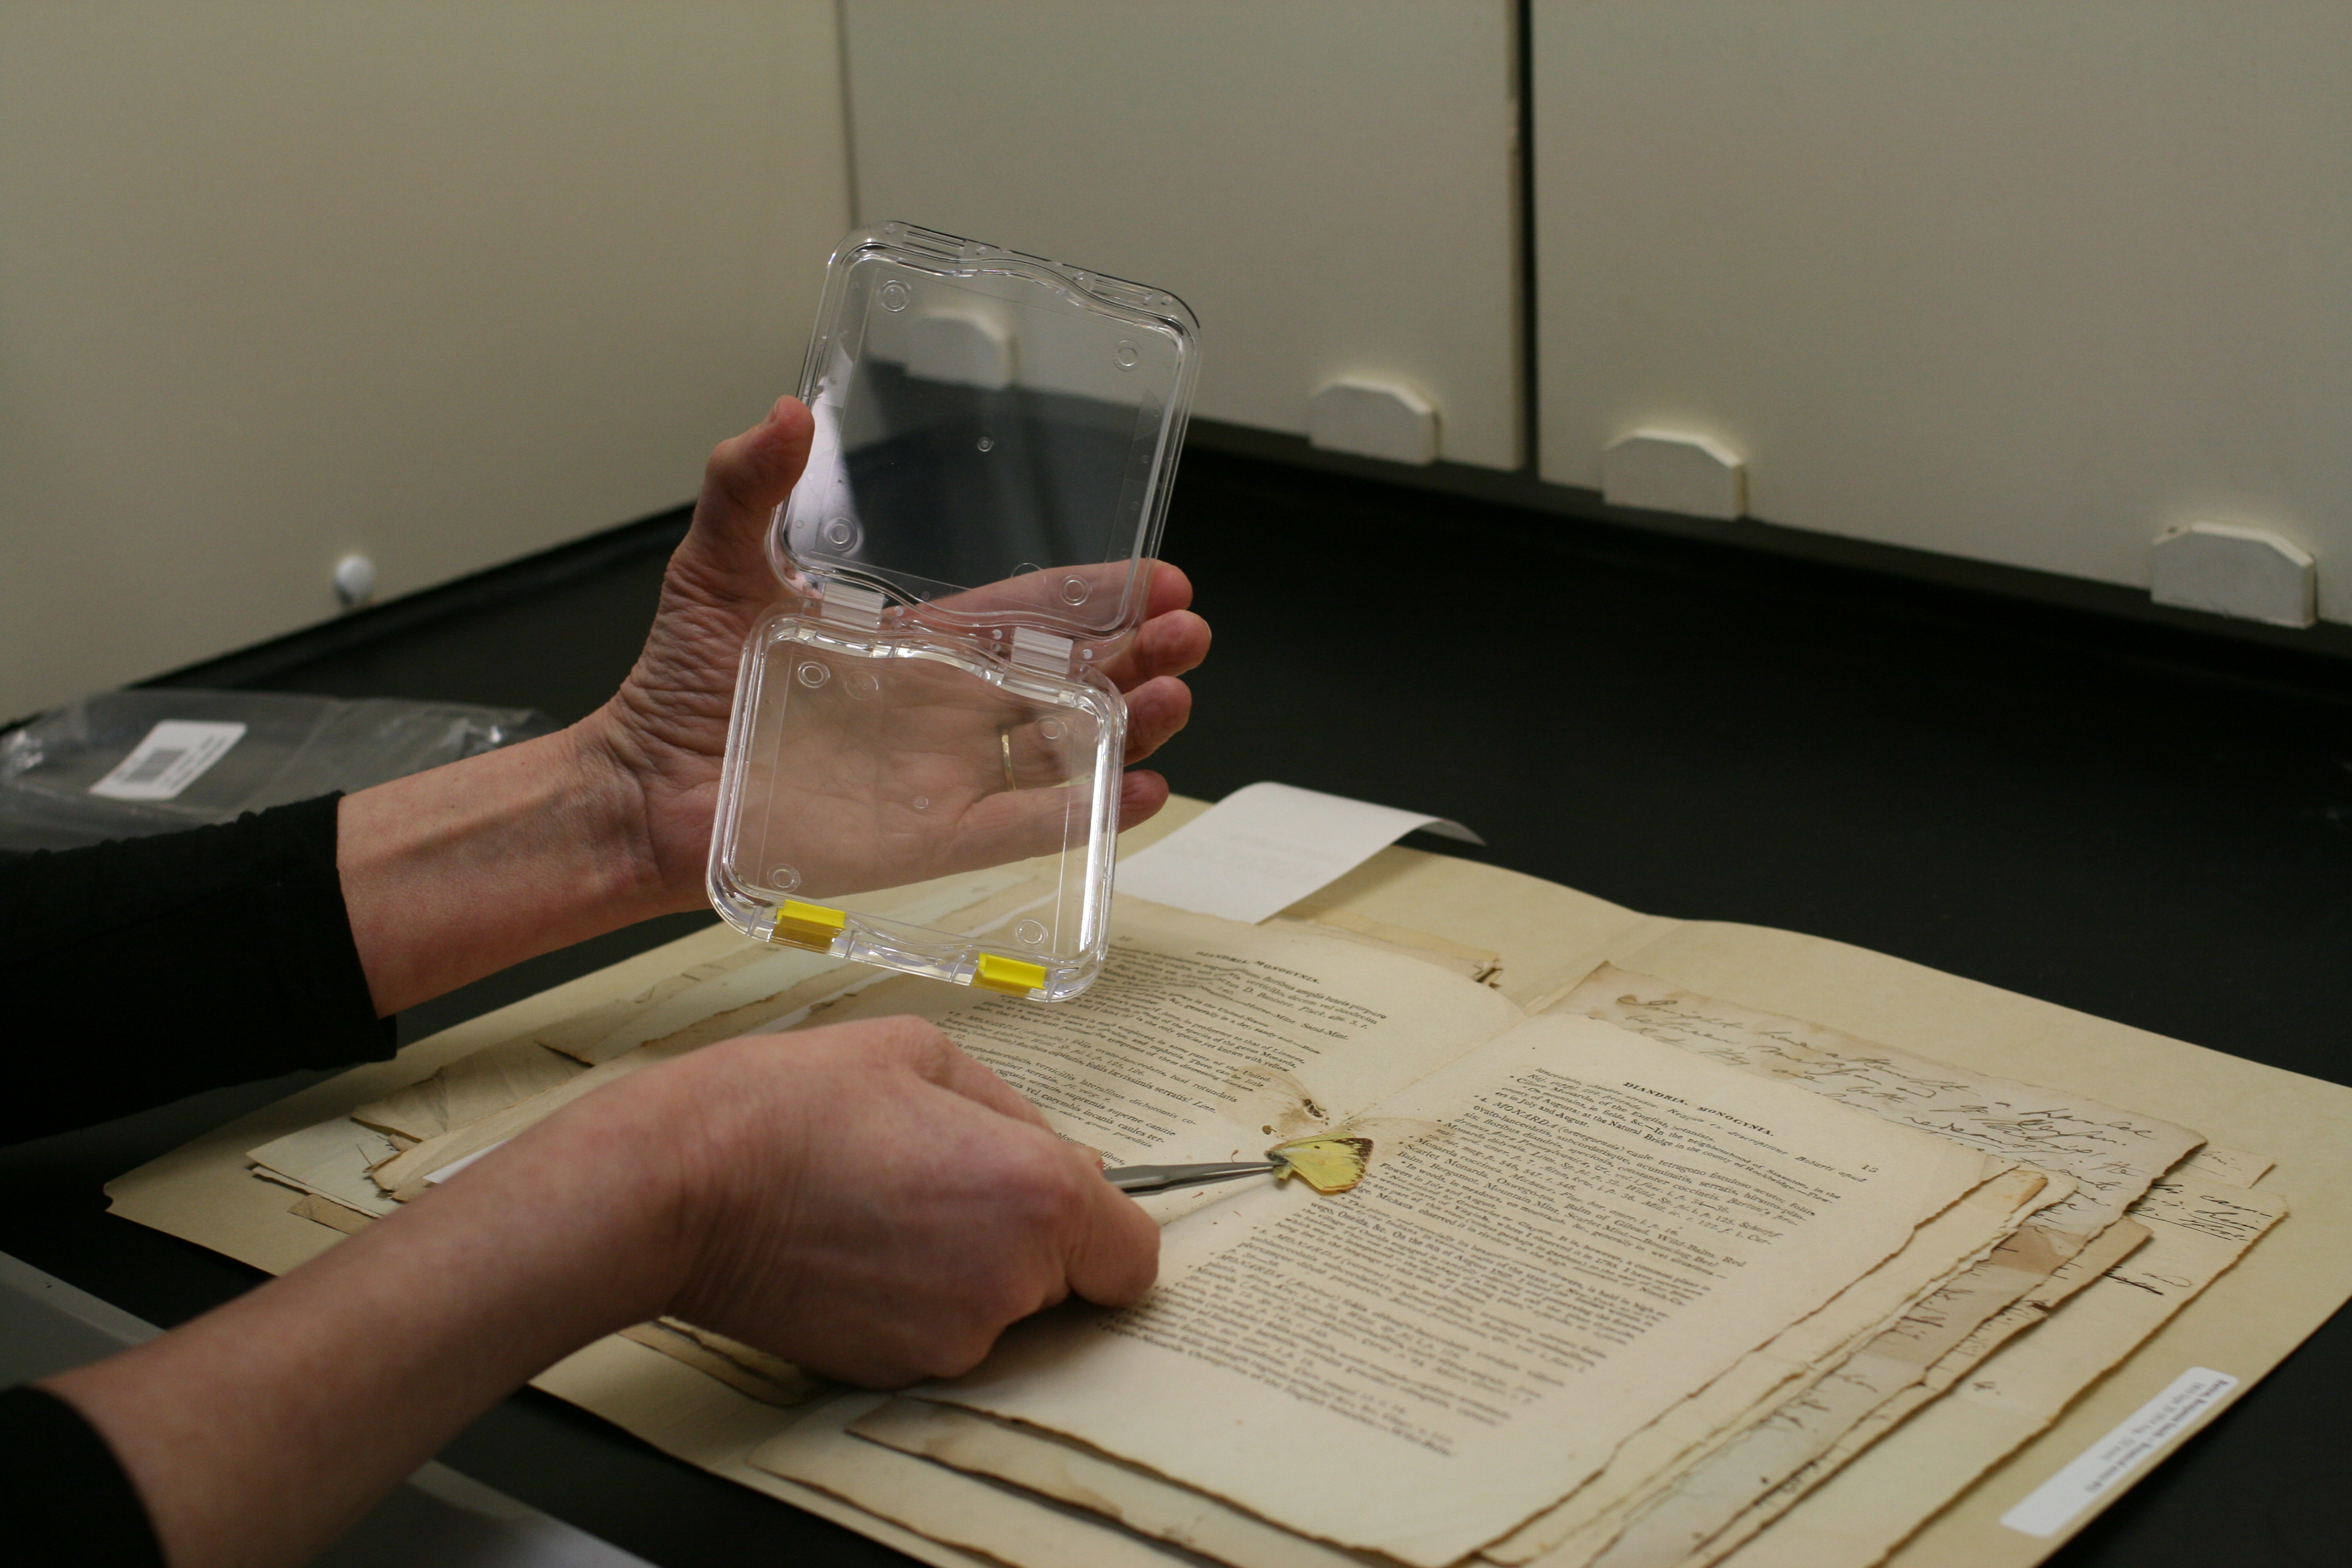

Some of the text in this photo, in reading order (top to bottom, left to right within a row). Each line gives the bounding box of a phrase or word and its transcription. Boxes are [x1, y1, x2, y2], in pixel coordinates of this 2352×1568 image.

[1254, 960, 1319, 984] MONOGYNIA.
[1216, 1045, 1243, 1057] known
[1244, 1055, 1262, 1063] with
[1264, 1061, 1290, 1072] yellow
[1260, 1051, 1296, 1068] Monarda,
[1192, 1083, 1237, 1102] rotundatis
[1040, 1094, 1081, 1111] corymbis
[1082, 1109, 1114, 1124] incanis
[1117, 1123, 1146, 1136] caules
[1146, 1134, 1165, 1143] ter-
[1129, 1099, 1178, 1119] dichotomis
[1191, 1100, 1215, 1113] Linn.
[1517, 1098, 1538, 1108] July
[1538, 1106, 1556, 1114] and
[1555, 1112, 1589, 1128] August.
[1622, 1082, 1773, 1136] DIANDRIA. MONOGYNIA.
[1106, 1108, 1144, 1123] superne
[1145, 1123, 1176, 1135] canitie
[1541, 1099, 1580, 1114] Augusta:
[1607, 1120, 1642, 1135] Natural
[1643, 1133, 1673, 1146] Bridge
[1492, 1102, 1558, 1128] MONARDA
[1626, 1150, 1653, 1160] caule
[1708, 1172, 1751, 1189] fistuloso
